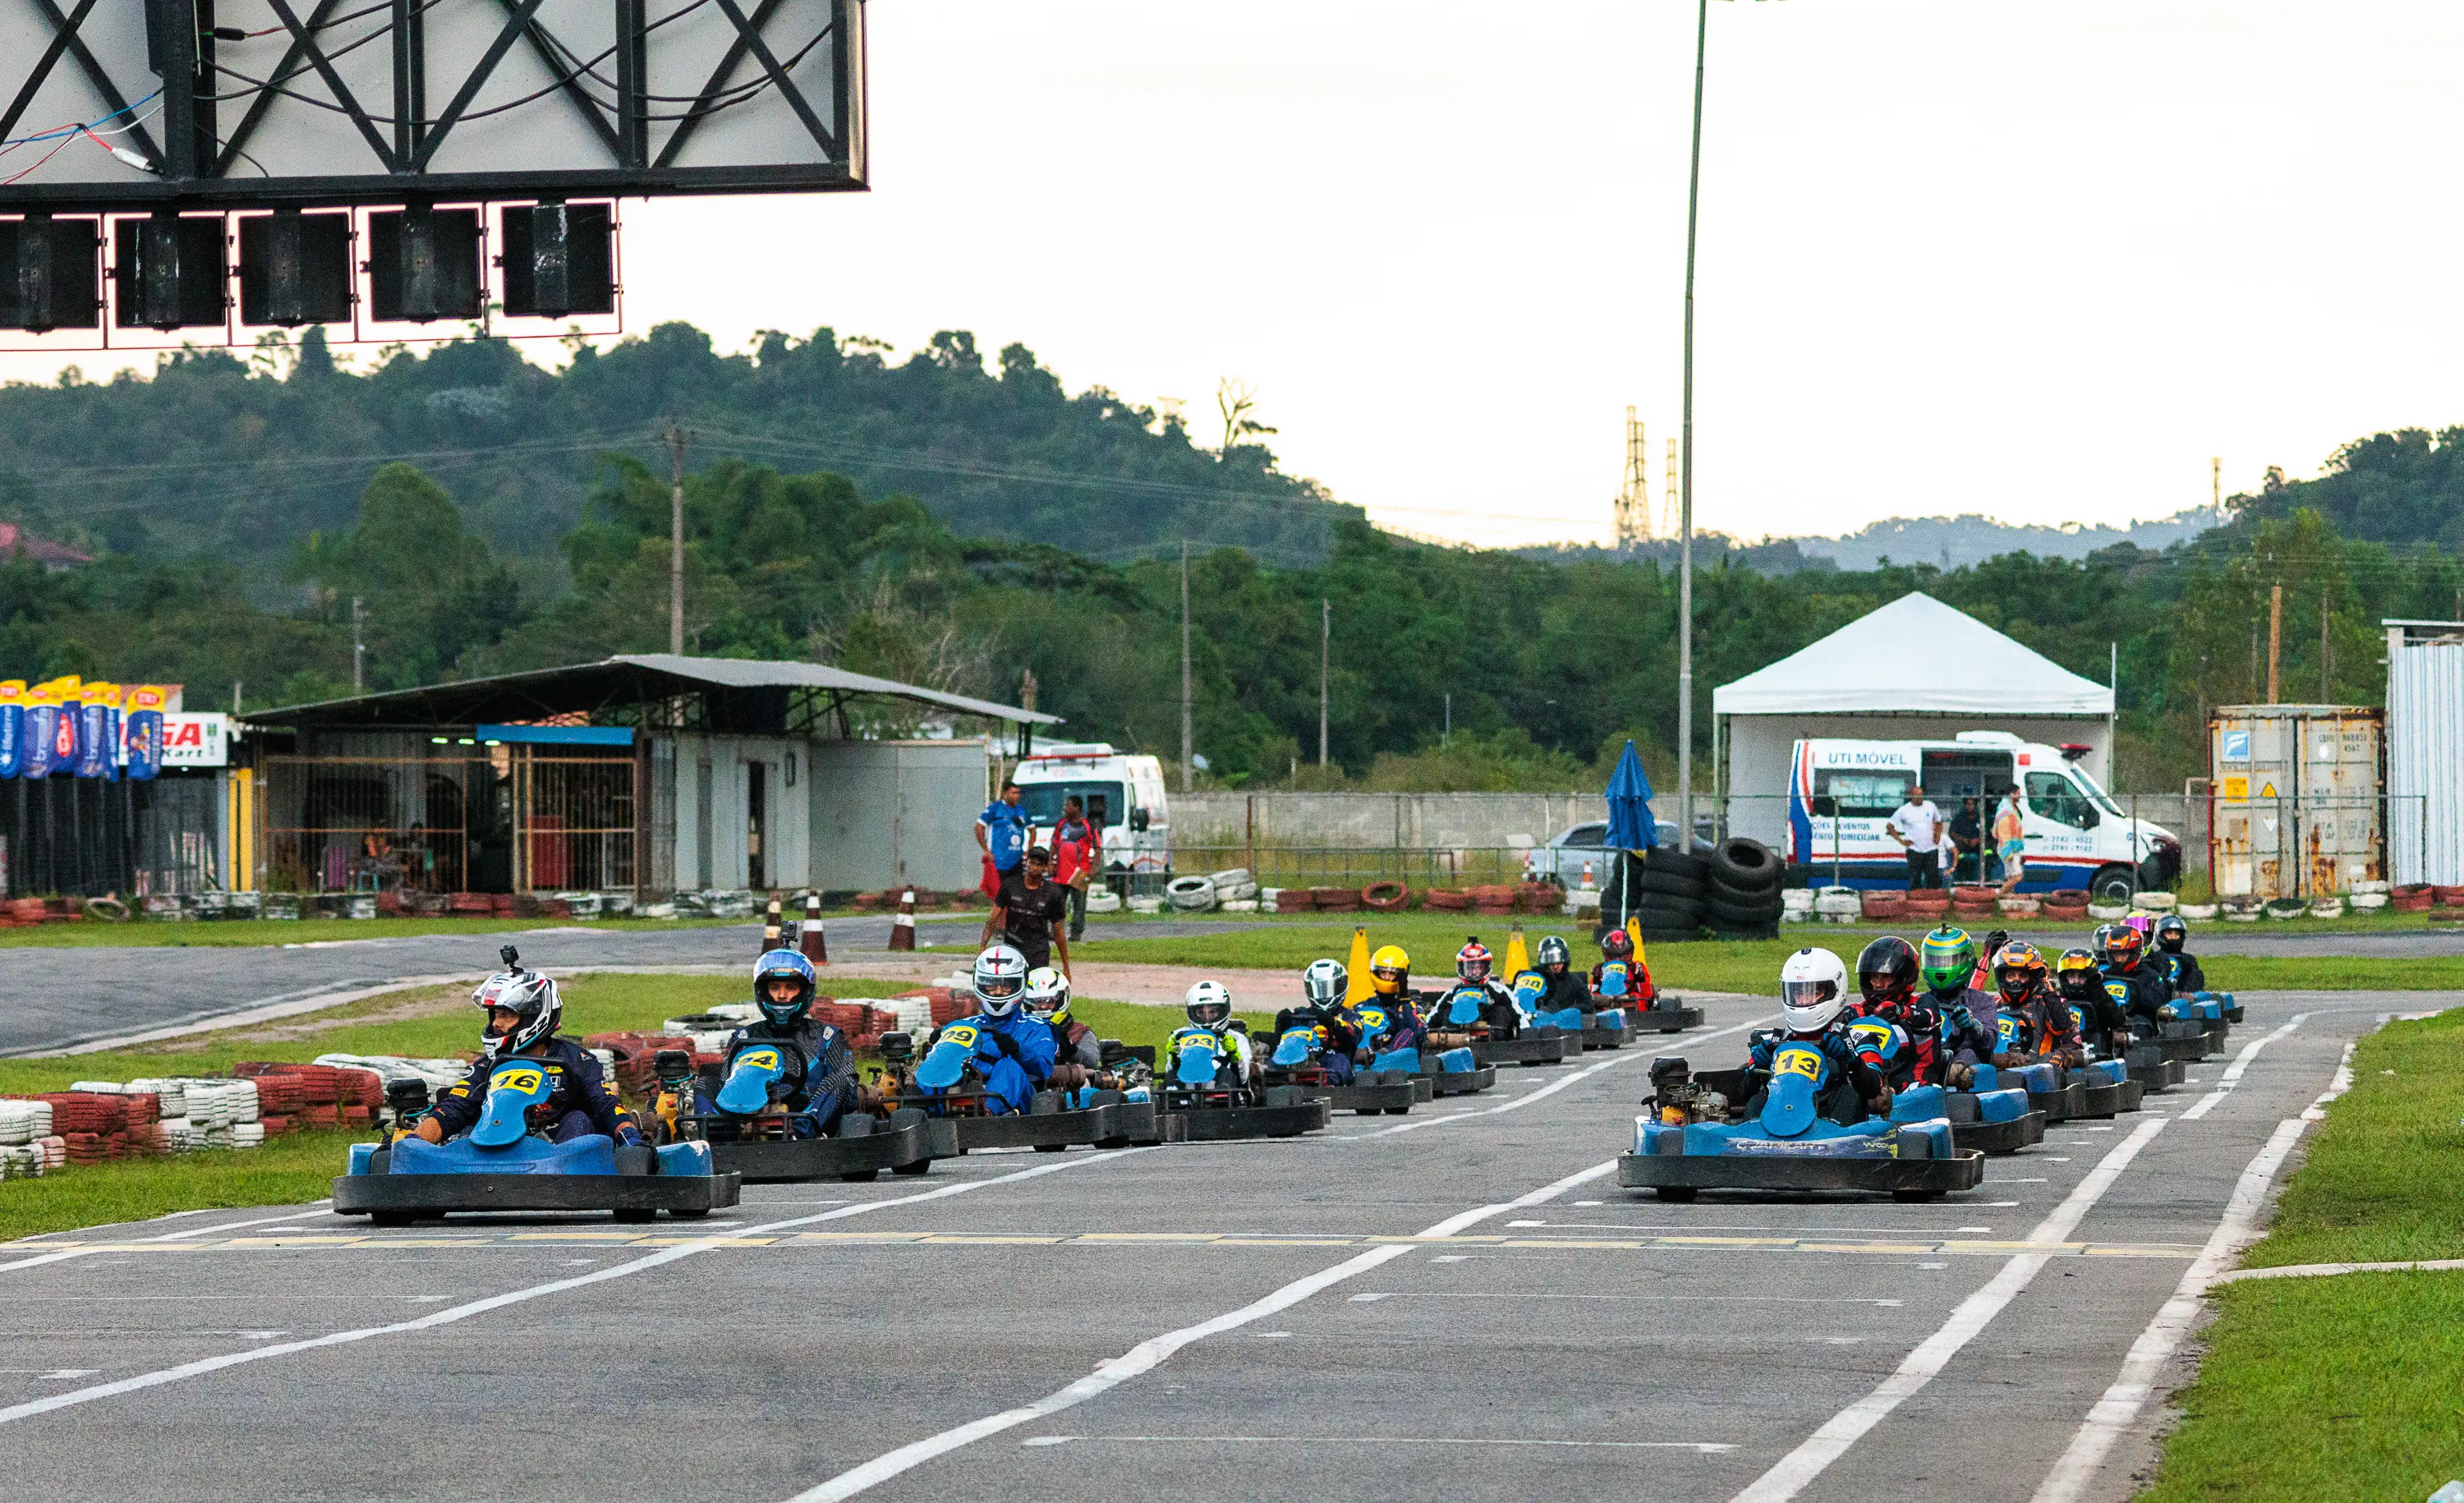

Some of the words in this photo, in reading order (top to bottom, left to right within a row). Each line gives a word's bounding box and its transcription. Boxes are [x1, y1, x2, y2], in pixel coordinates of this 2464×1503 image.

[1828, 752, 1851, 764] UTI
[1855, 751, 1907, 765] MÓVEL
[517, 1015, 549, 1047] LS2
[942, 1030, 972, 1041] 09
[1186, 1037, 1212, 1046] 03
[1781, 1054, 1818, 1075] 13
[496, 1075, 538, 1090] 16
